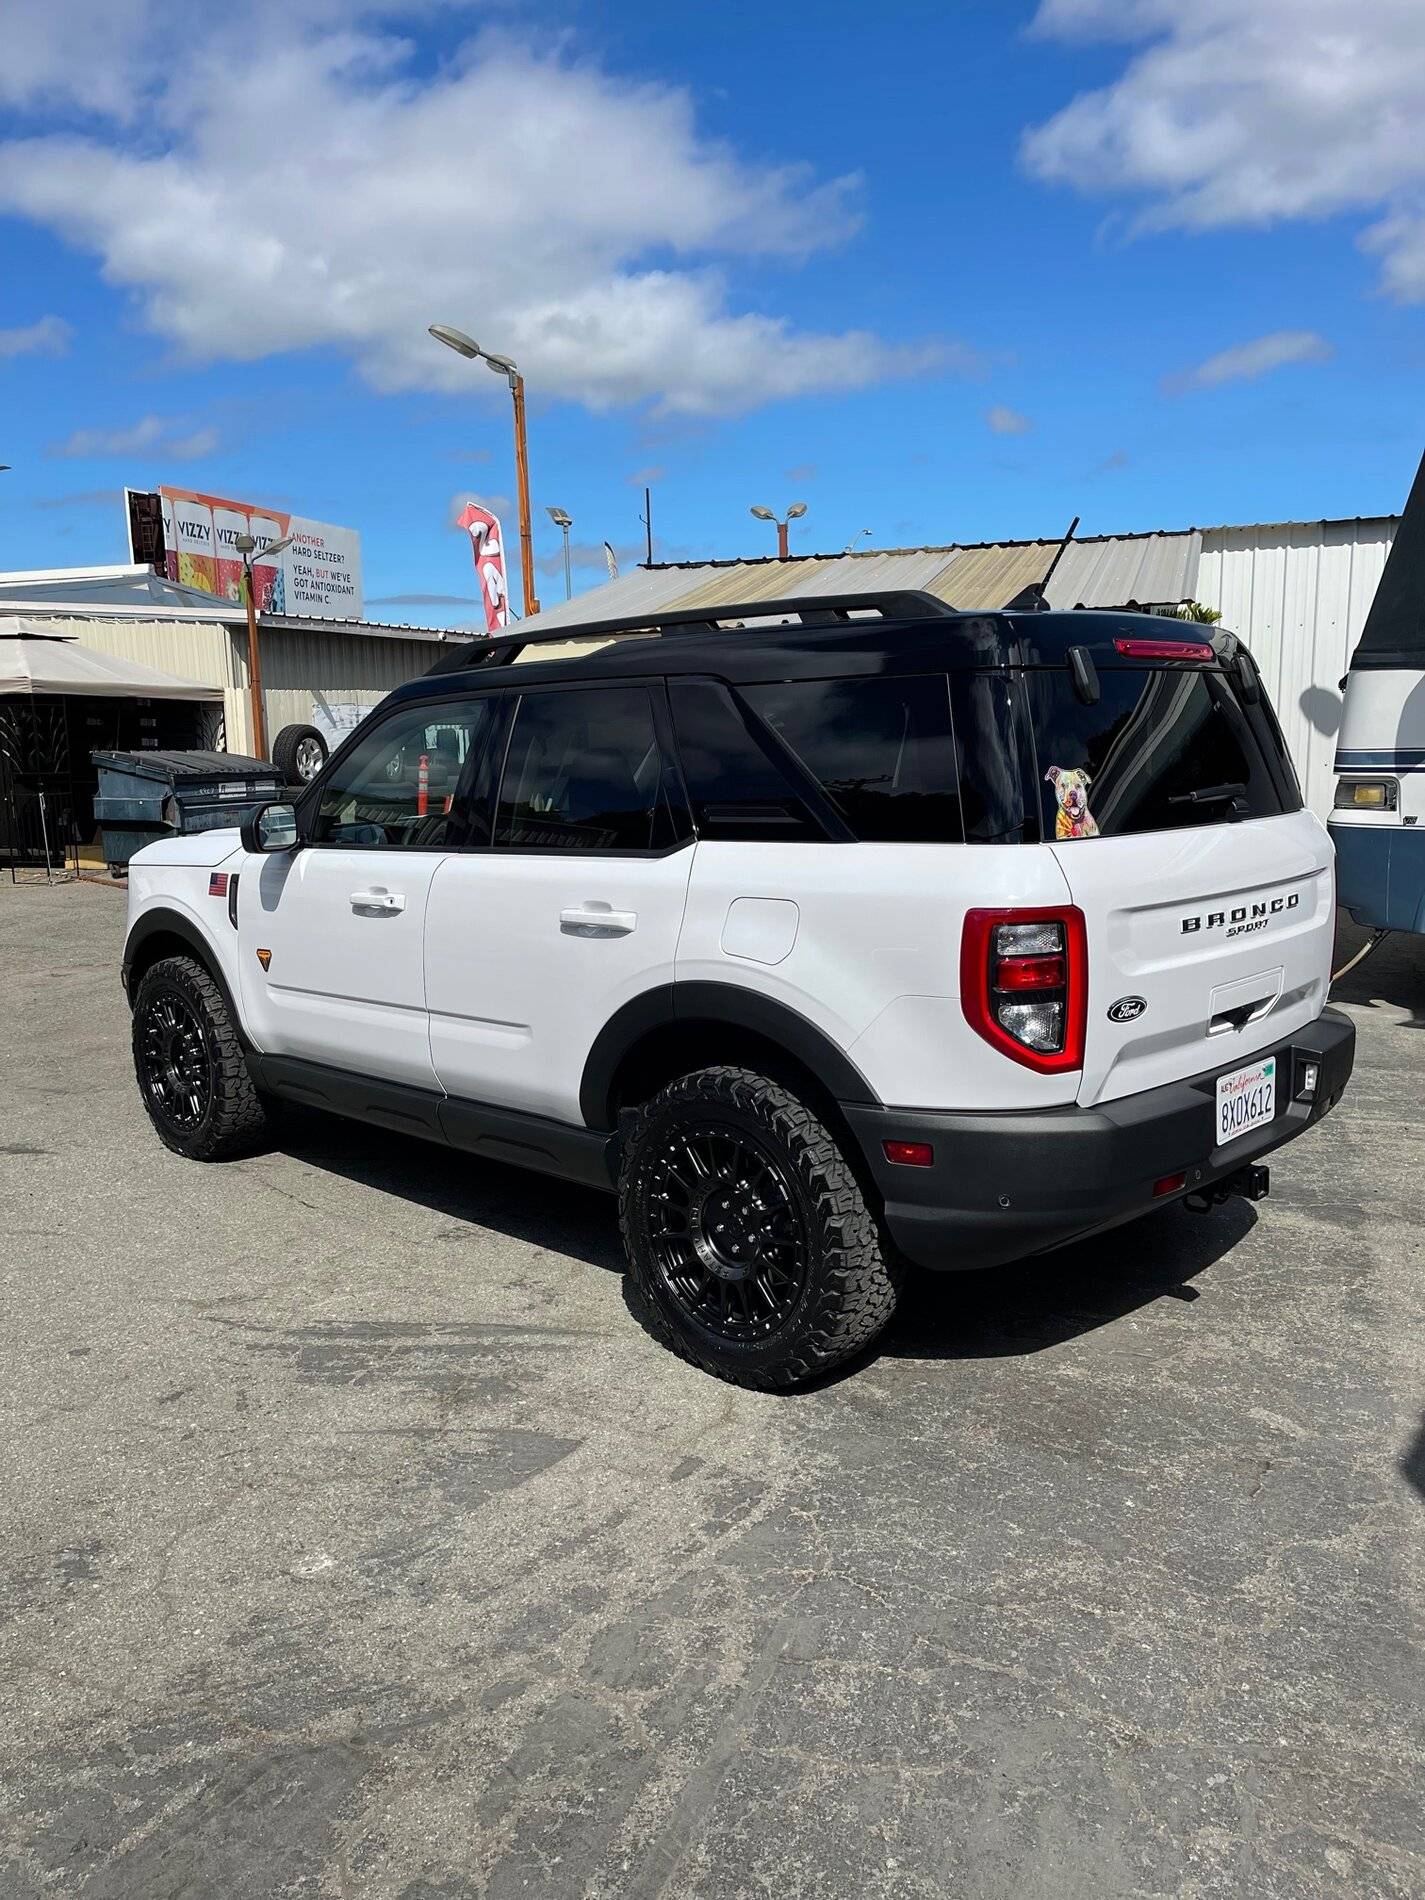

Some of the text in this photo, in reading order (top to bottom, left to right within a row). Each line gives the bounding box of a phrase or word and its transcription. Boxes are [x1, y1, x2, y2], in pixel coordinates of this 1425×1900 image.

[178, 521, 210, 540] VIZZY
[216, 528, 243, 545] VIZZ
[292, 533, 325, 548] ANOTHER
[292, 546, 345, 563] HARD SELTZER?
[293, 564, 351, 583] YEAH, BUT WE'VE
[293, 578, 355, 596] GOT ANTIOXIDANT
[294, 591, 332, 605] VITAMIN C.
[1180, 893, 1299, 935] BRONCO
[1225, 918, 1270, 938] SPORT
[1118, 1001, 1141, 1018] Ford
